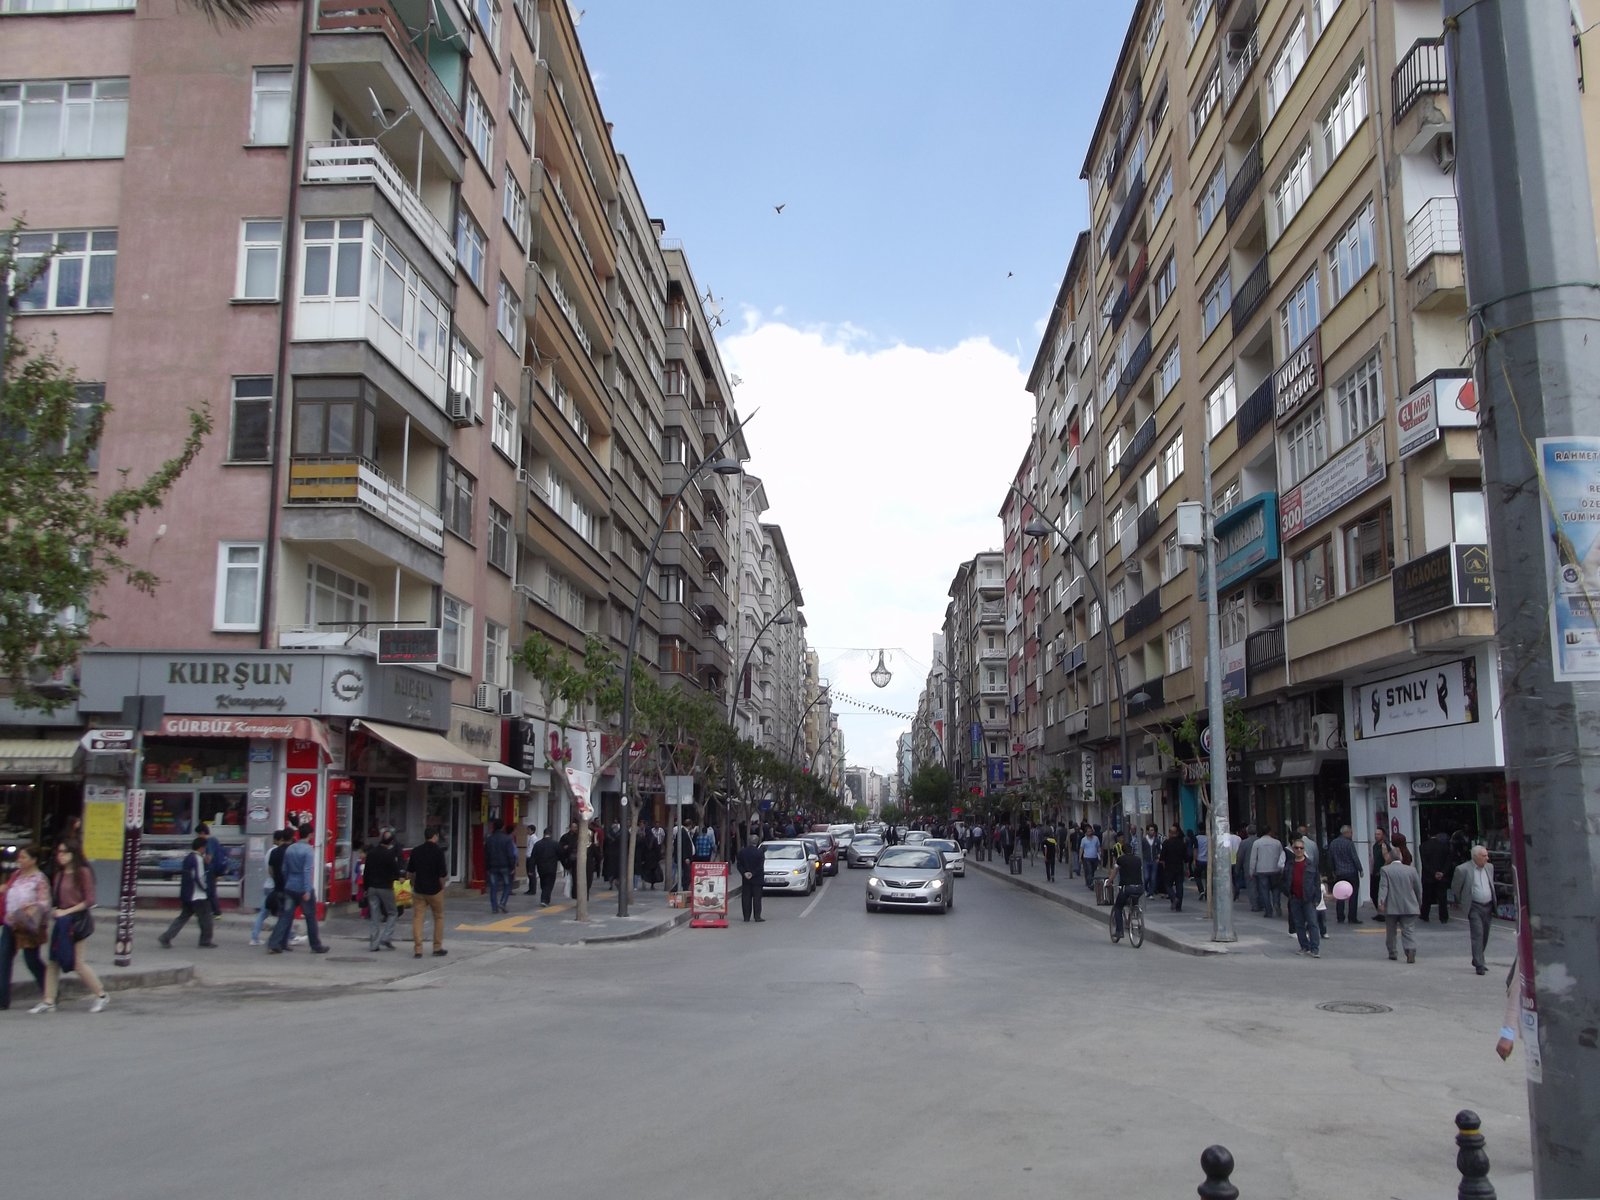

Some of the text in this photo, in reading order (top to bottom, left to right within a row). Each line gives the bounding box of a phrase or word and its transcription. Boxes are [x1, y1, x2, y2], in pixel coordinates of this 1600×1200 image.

[1278, 345, 1310, 394] AVUKAT
[1285, 364, 1315, 407] BAŞBUĞ
[1555, 452, 1600, 461] RAHMET
[1282, 507, 1301, 533] 300
[168, 662, 293, 690] KURŞUN
[1386, 680, 1427, 707] STNLY
[167, 718, 294, 736] GÜRBÜZ Kuruyemiş
